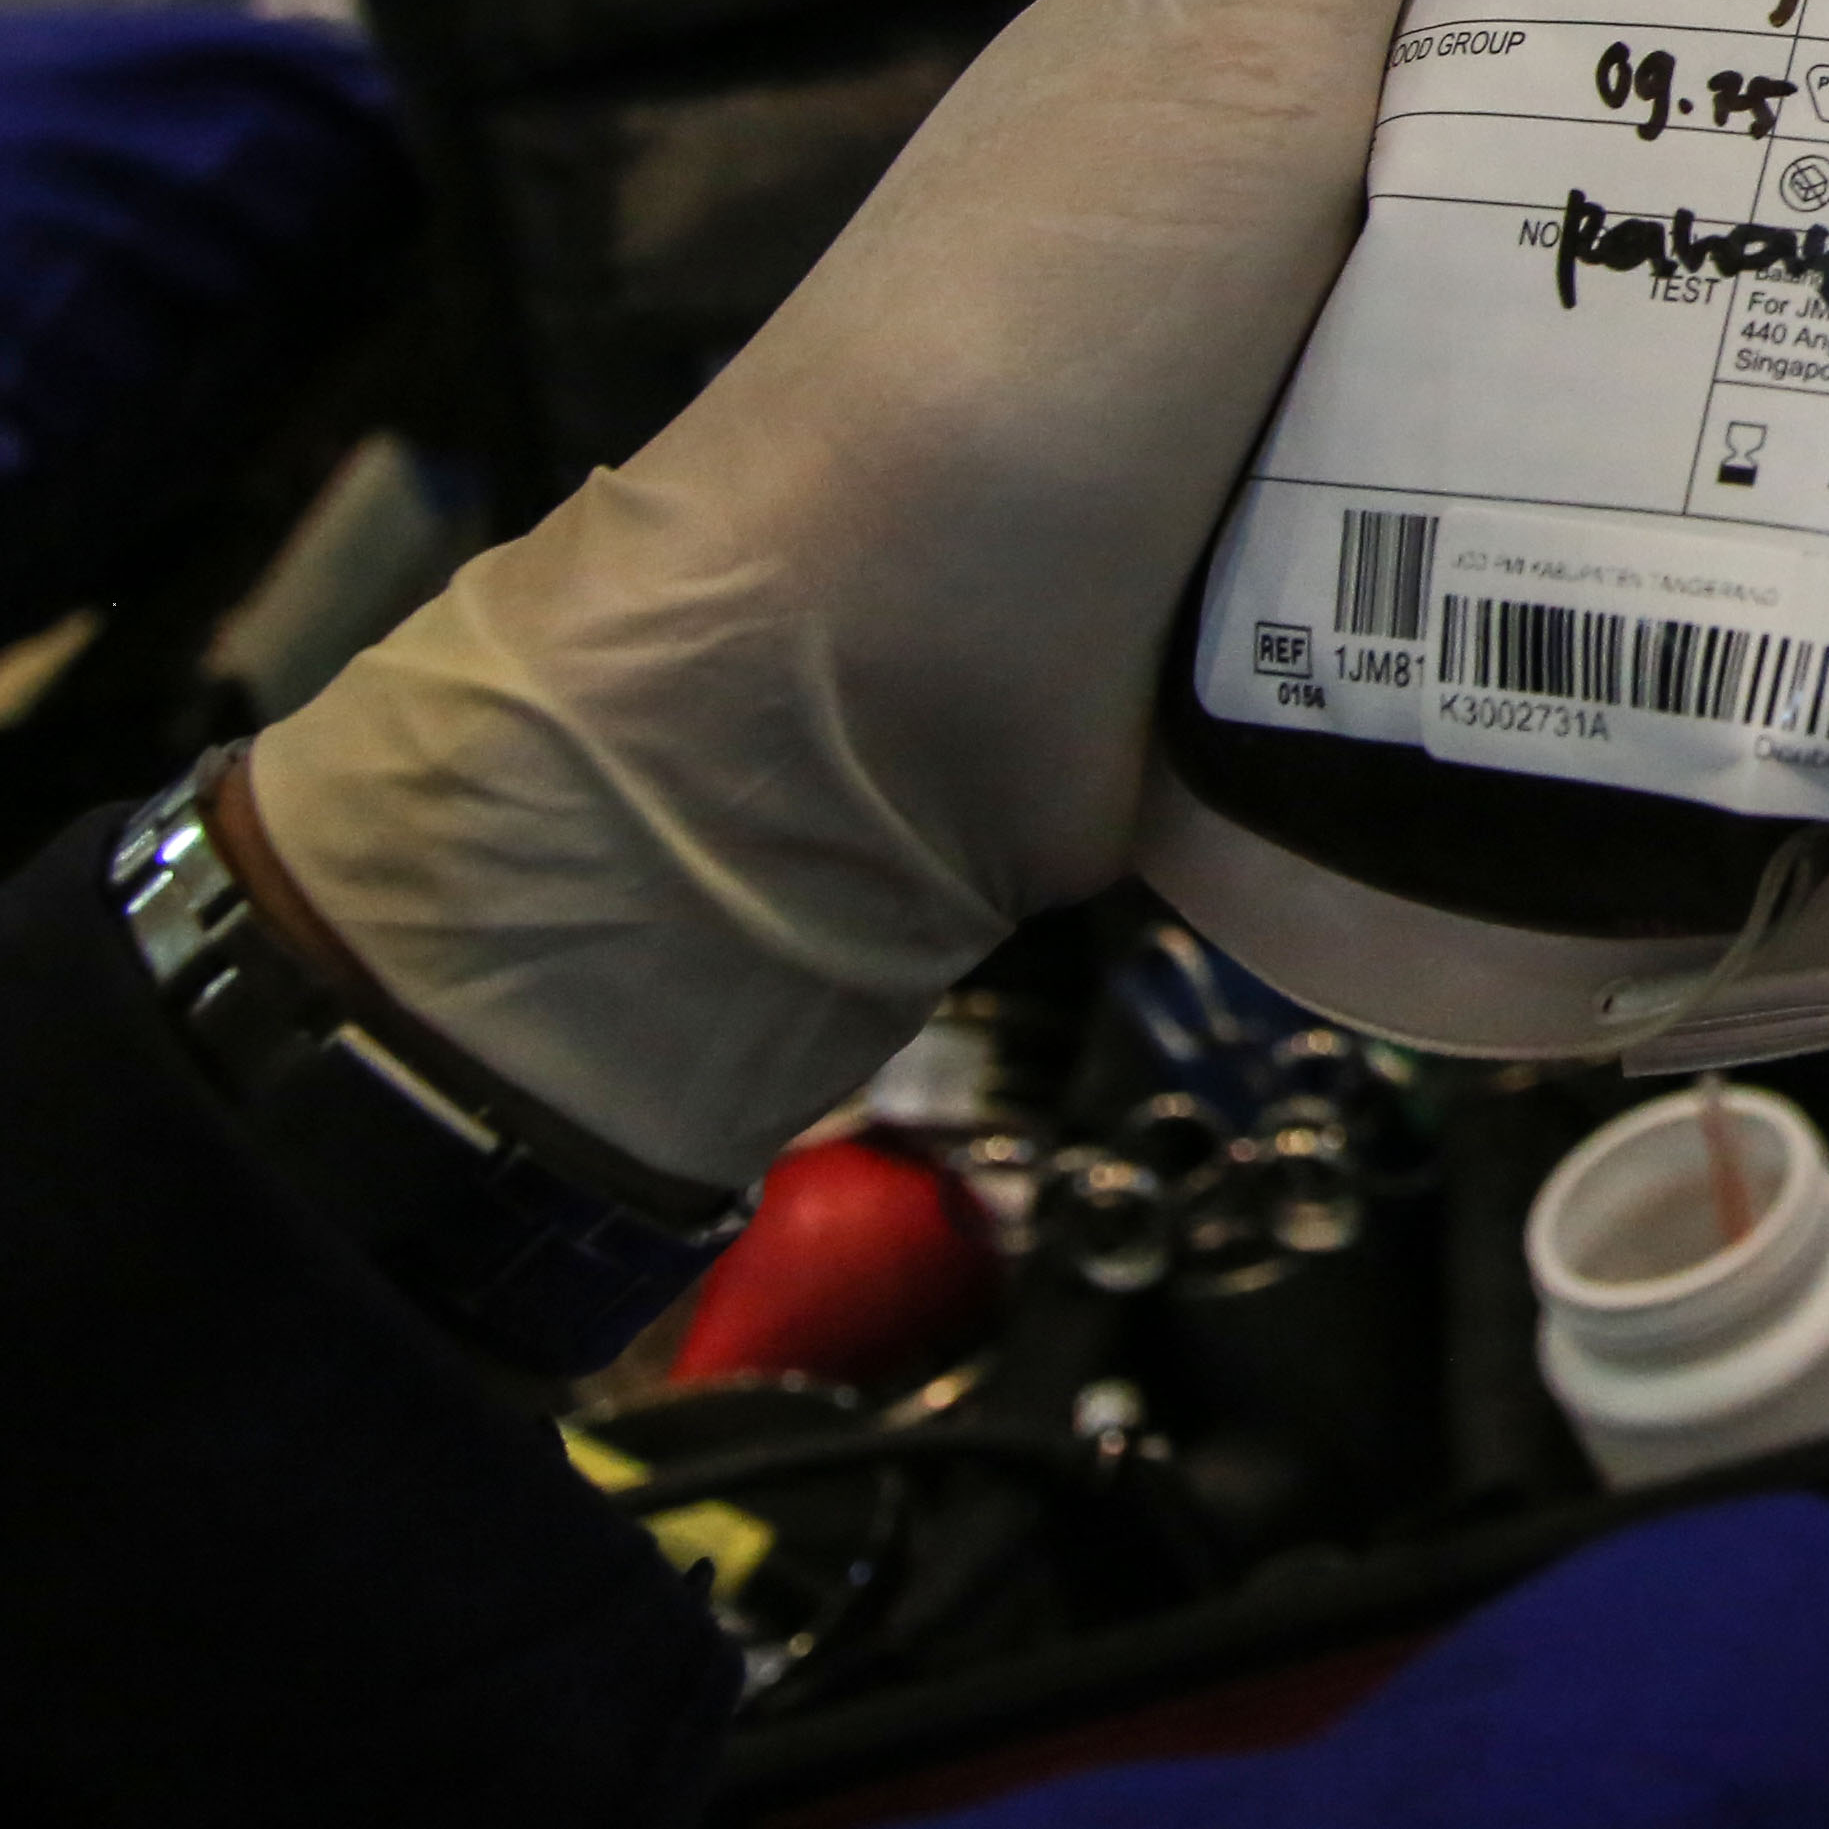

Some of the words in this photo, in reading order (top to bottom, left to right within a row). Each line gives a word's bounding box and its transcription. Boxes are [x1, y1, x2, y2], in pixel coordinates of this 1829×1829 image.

[1437, 30, 1526, 57] GROUP
[1650, 274, 1722, 305] TEST
[1748, 291, 1790, 315] For
[1740, 321, 1788, 345] 440
[1260, 633, 1306, 665] REF
[1438, 693, 1611, 742] K3002731A
